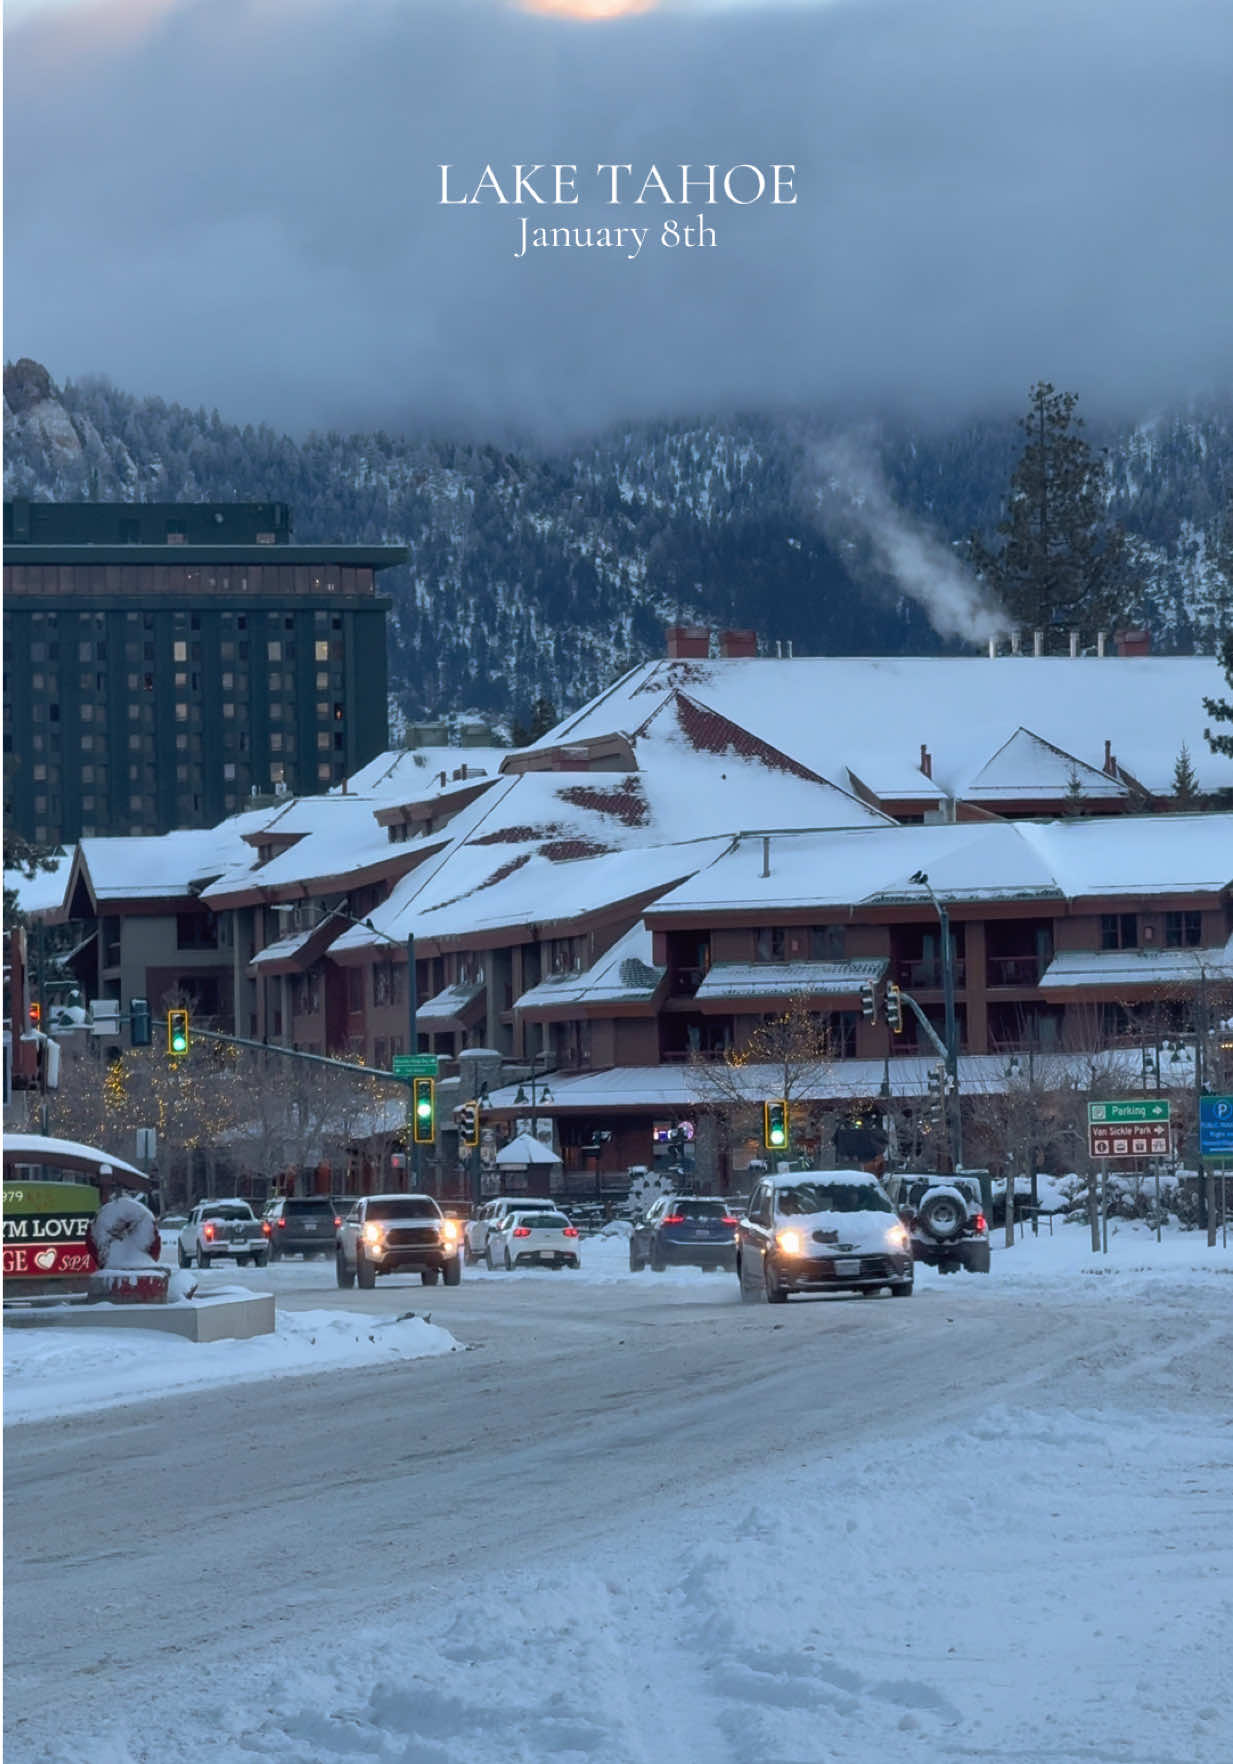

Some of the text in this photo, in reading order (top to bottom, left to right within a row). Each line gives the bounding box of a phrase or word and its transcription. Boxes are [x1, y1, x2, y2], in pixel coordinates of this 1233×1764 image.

[1112, 1105, 1146, 1118] Parking
[1093, 1127, 1108, 1137] Van
[1134, 1125, 1152, 1136] Park
[58, 1253, 90, 1272] SPA
